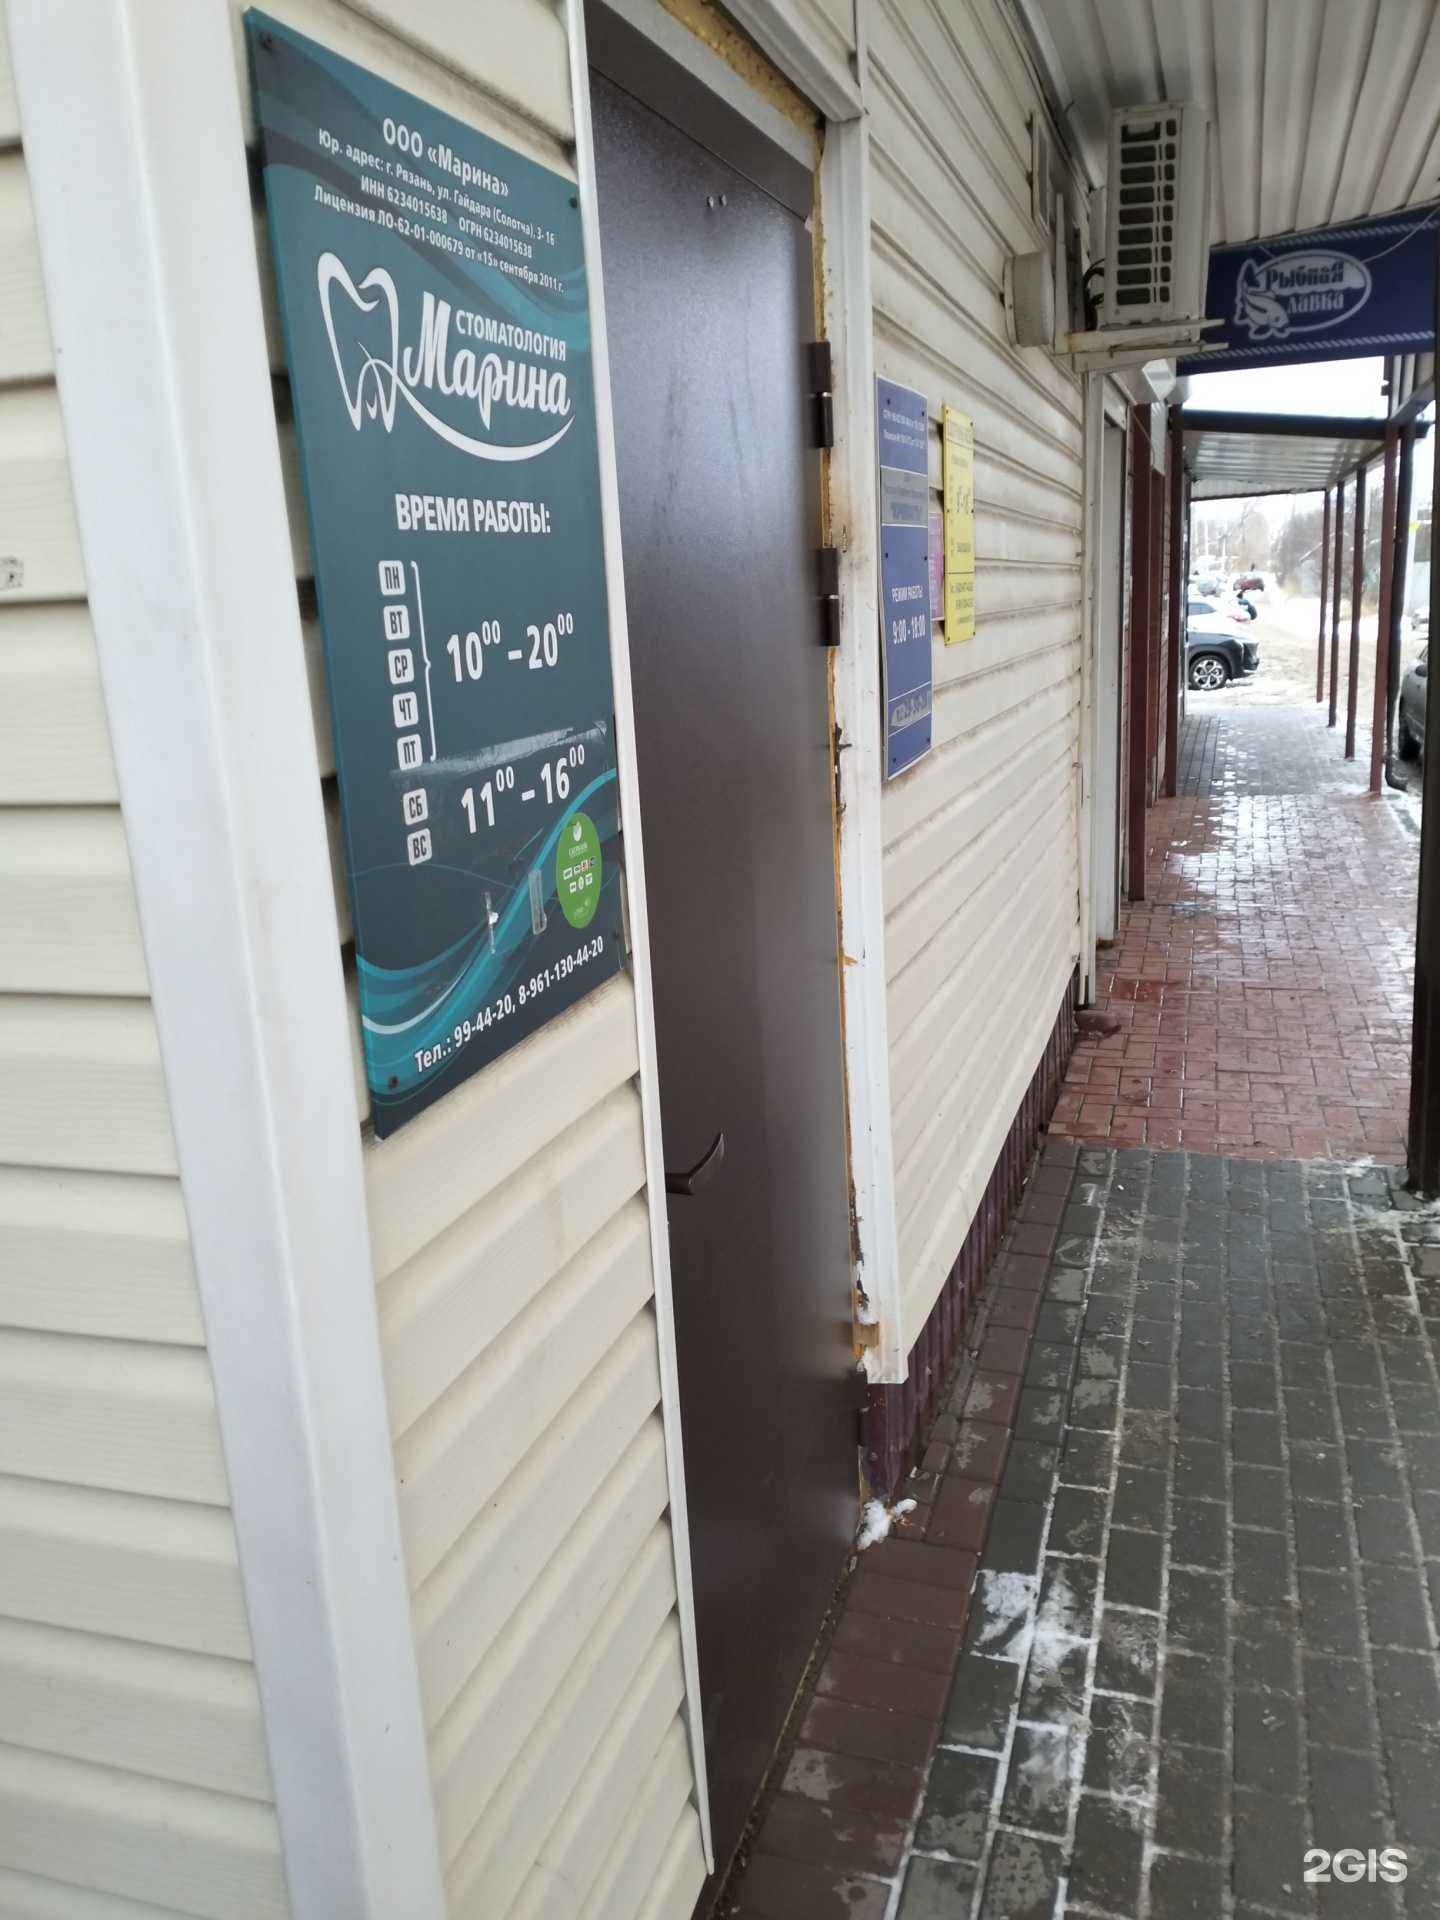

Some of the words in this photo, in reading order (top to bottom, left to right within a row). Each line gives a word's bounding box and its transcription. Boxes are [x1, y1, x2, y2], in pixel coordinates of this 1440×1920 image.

[319, 127, 343, 155] Юр.
[346, 145, 384, 172] адрес:
[396, 163, 435, 196] Рязань,
[437, 184, 452, 201] ул.
[454, 189, 491, 219] Гайдара
[383, 118, 423, 158] ООО
[427, 144, 509, 197] «Марина»
[361, 175, 385, 199] ИНН
[387, 186, 448, 225] 6234015638
[459, 217, 482, 240] ОГРН
[314, 185, 376, 223] Лицензия
[377, 209, 463, 256] ЛО-62-01-000679
[500, 260, 538, 285] сентября
[540, 272, 557, 291] 2011
[456, 310, 566, 361] СТОМАТОЛОГИЯ
[403, 291, 570, 431] Марина
[395, 493, 470, 532] ВРЕМЯ
[473, 499, 550, 533] РАБОТЫ:
[385, 566, 399, 589] ПН
[390, 611, 403, 633] ВТ
[394, 655, 408, 678] СР
[399, 698, 412, 721] ЧТ
[403, 740, 416, 763] ПТ
[409, 795, 422, 818] СБ
[413, 835, 427, 857] ВС
[415, 1038, 451, 1073] Тел.:
[454, 994, 516, 1048] 99-44-20,
[519, 935, 603, 1005] 8-961-130-44-20
